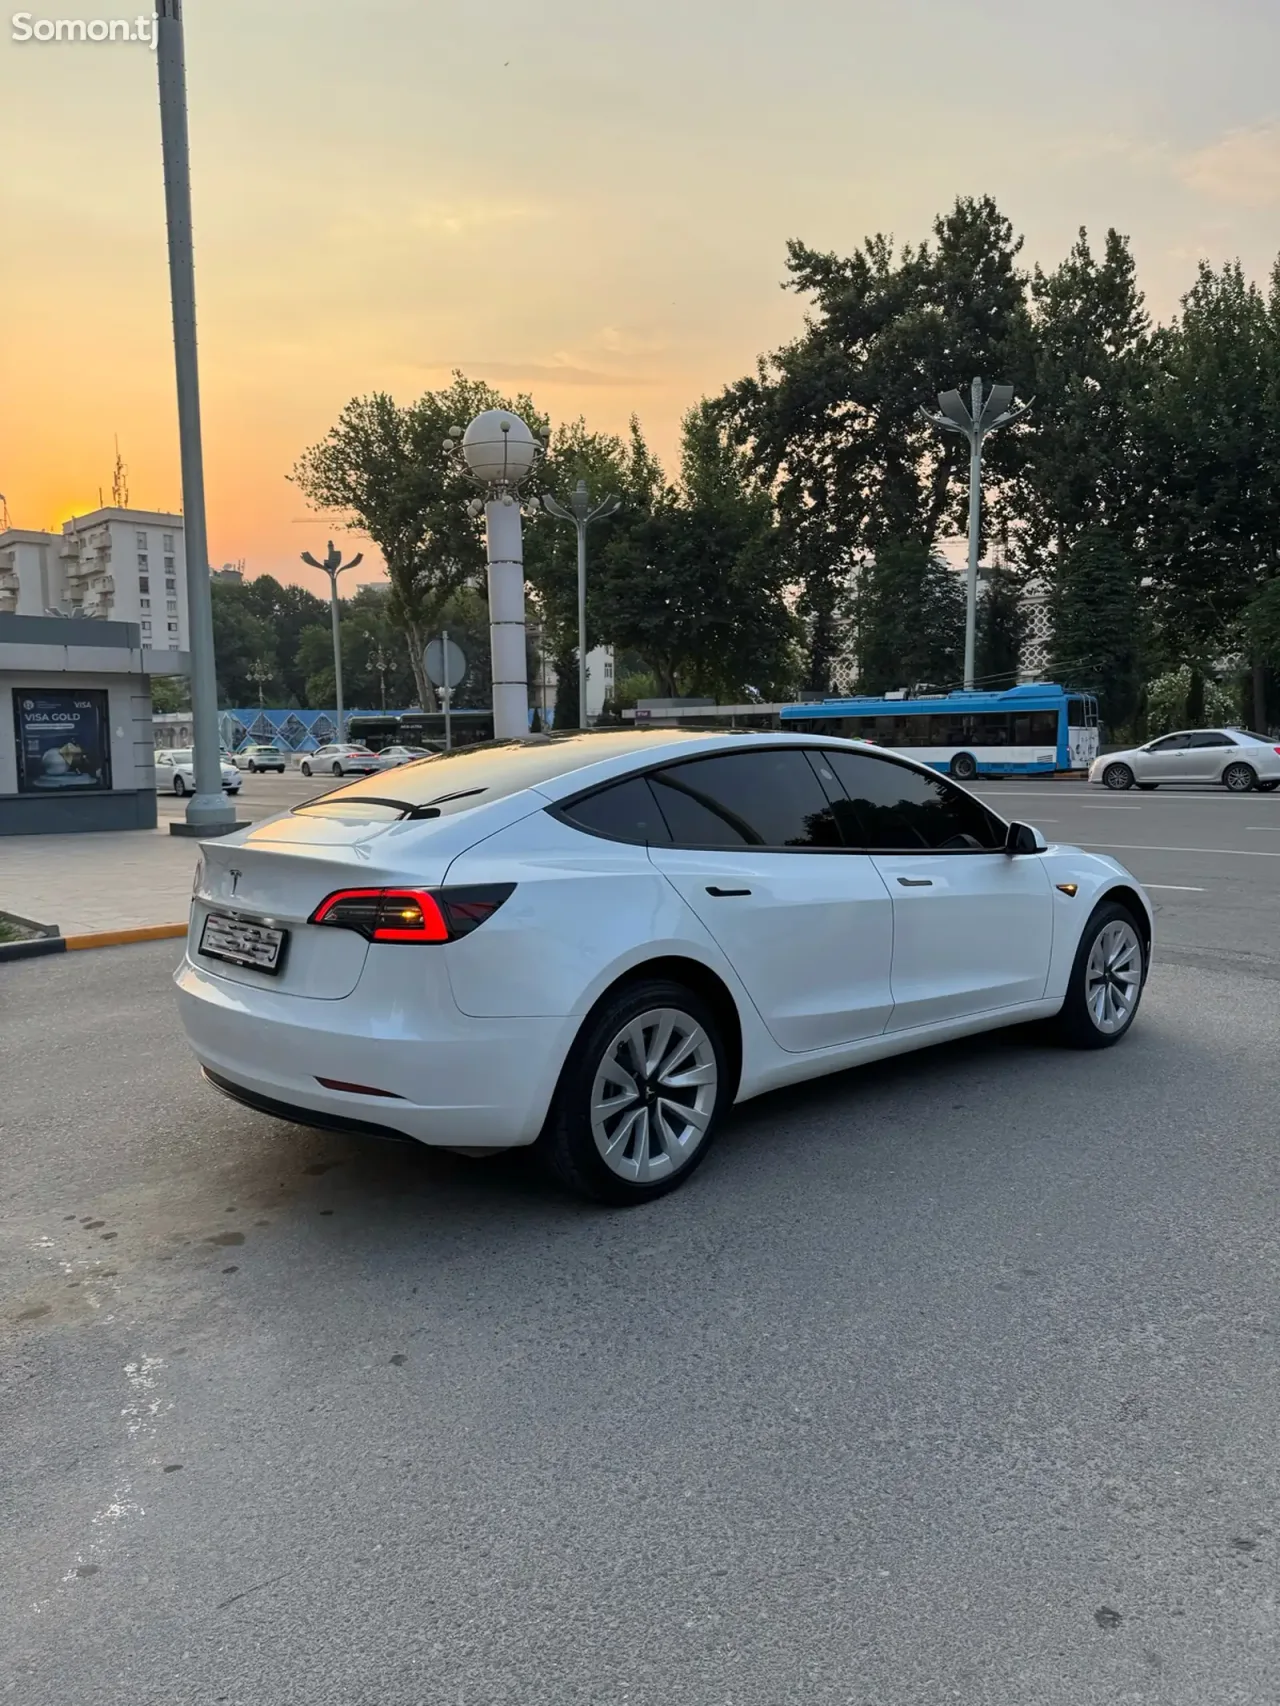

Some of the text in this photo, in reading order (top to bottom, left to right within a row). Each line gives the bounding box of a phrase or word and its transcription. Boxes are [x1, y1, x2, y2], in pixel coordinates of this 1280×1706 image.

[74, 701, 92, 709] VISA
[24, 713, 82, 722] VISA GOLD
